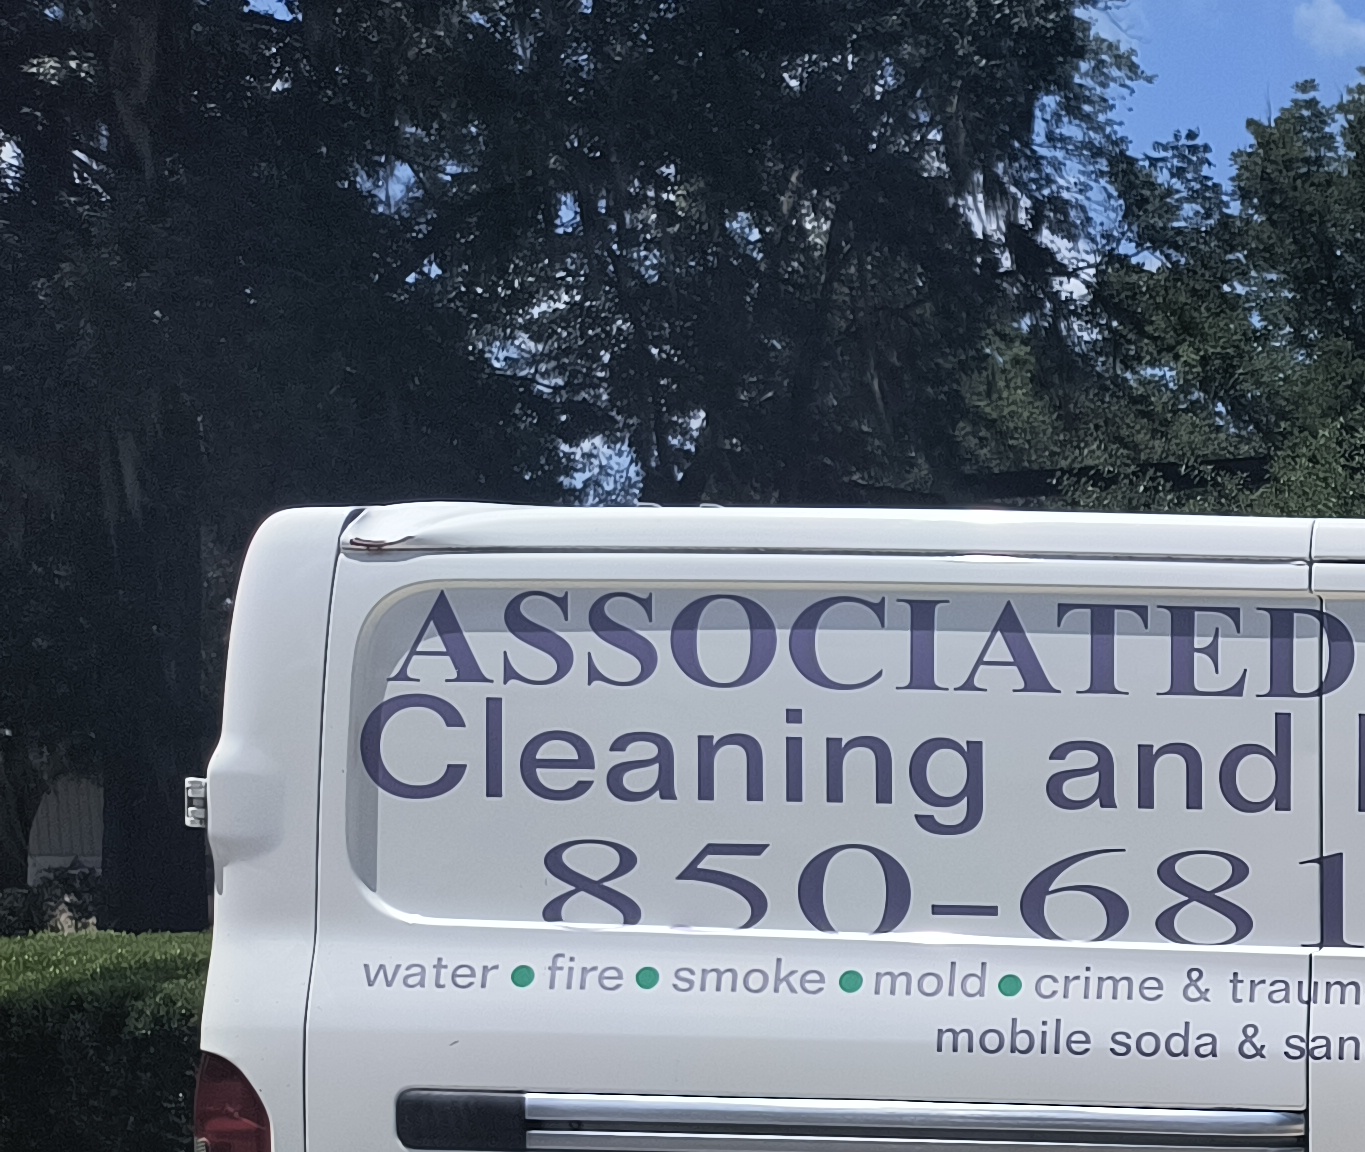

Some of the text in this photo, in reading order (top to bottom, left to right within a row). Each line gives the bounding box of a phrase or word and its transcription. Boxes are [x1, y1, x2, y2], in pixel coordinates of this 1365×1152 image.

[388, 590, 1357, 699] ASSOCIATED
[360, 692, 985, 836] Cleaning
[1044, 712, 1293, 812] and
[363, 957, 498, 991] water
[547, 953, 625, 992] fire
[672, 956, 826, 996] smoke
[873, 961, 987, 1000] mold
[1034, 965, 1164, 1003] crime
[1182, 968, 1211, 1003] &
[936, 1019, 1092, 1057] mobile
[1109, 1021, 1219, 1059] soda
[1238, 1025, 1266, 1060] &
